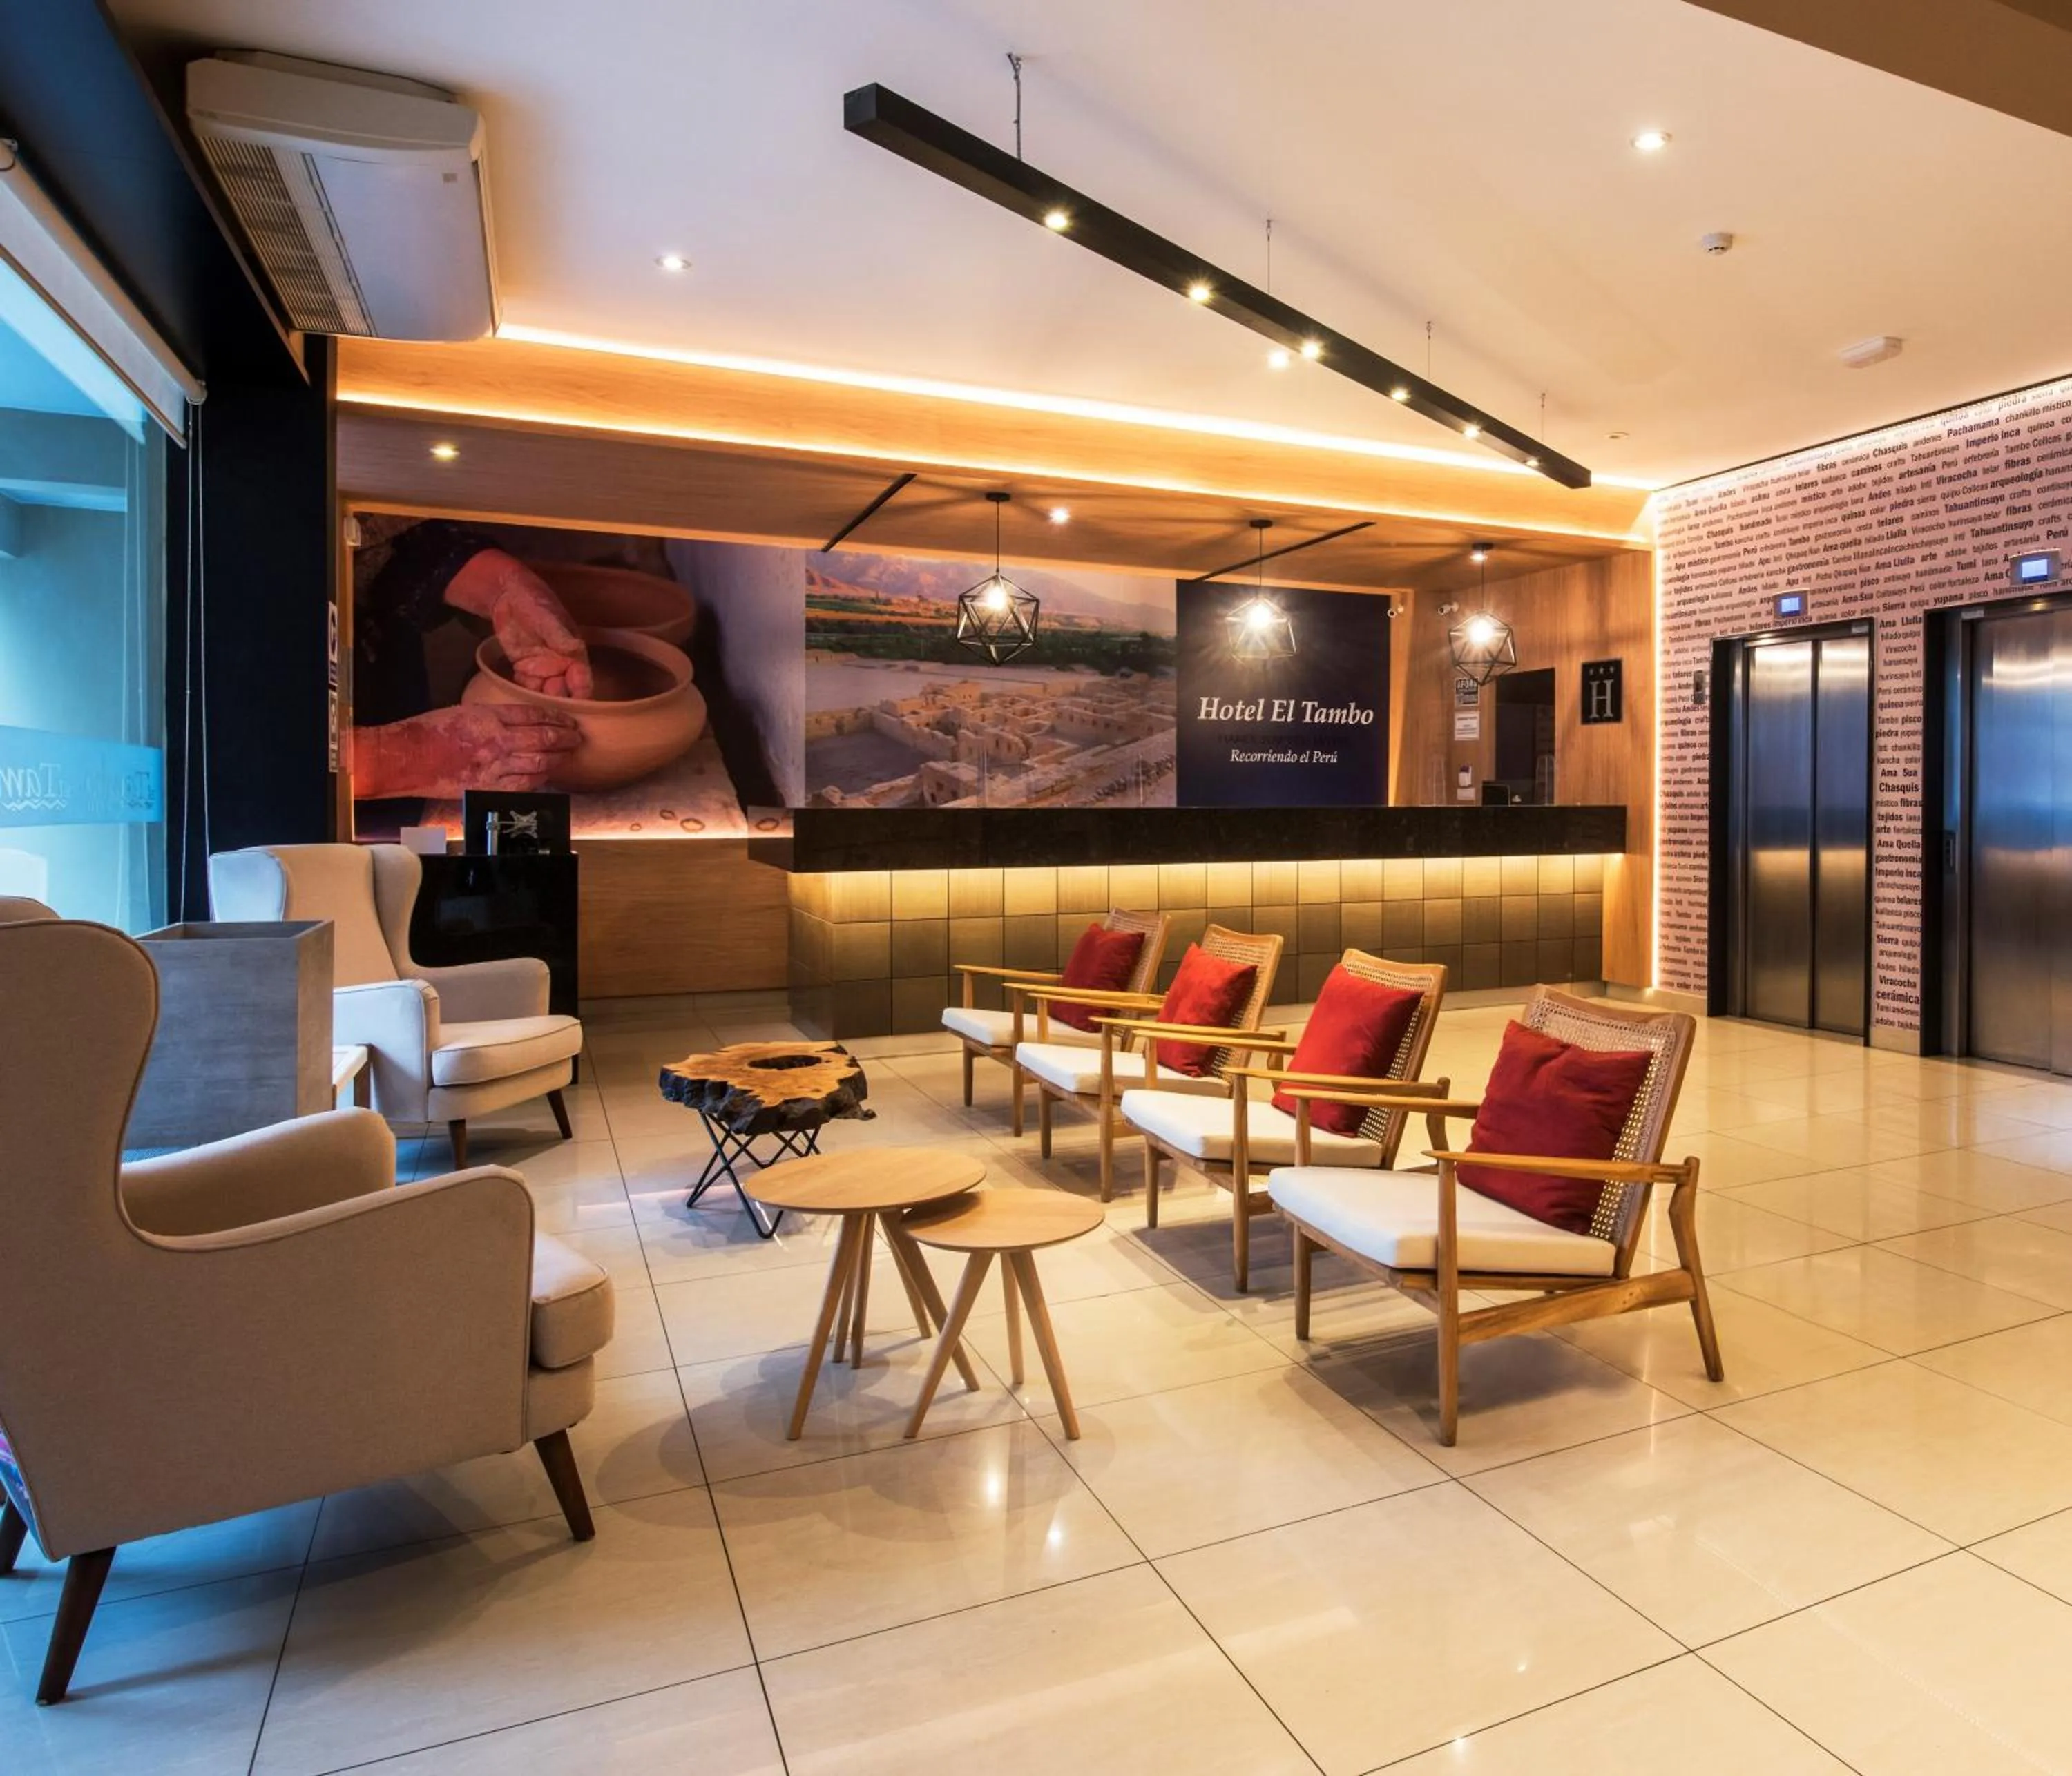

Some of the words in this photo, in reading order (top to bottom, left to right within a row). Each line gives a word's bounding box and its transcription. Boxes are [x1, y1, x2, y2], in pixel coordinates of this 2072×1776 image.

[1872, 440, 1908, 459] Chasquis
[1946, 416, 1999, 439] Pachamama
[1966, 431, 1998, 450] Imperio
[1936, 466, 1977, 485] Viracocha
[2005, 454, 2031, 470] fibras
[1877, 514, 1903, 528] telares
[1944, 492, 2004, 515] Tahuantinsuyo
[2006, 501, 2032, 517] fibras
[1970, 517, 2033, 540] Tahuantinsuyo
[2046, 525, 2068, 540] Perú
[1984, 569, 2003, 581] Ama
[1882, 599, 1905, 612] Sierra
[1933, 591, 1964, 606] yupana
[1879, 617, 1896, 629] Ama
[1589, 679, 1614, 718] H
[1197, 697, 1265, 722] Hotel
[1270, 699, 1295, 722] El
[1301, 701, 1374, 724] Tambo
[1875, 728, 1899, 740] piedra
[1230, 749, 1297, 763] Recorriendo
[1299, 751, 1310, 763] el
[1312, 751, 1338, 763] Perú
[1879, 782, 1919, 794] Chasquis
[1876, 934, 1899, 946] Sierra
[1878, 974, 1917, 990] Viracocha
[1875, 986, 1919, 1006] cerámica
